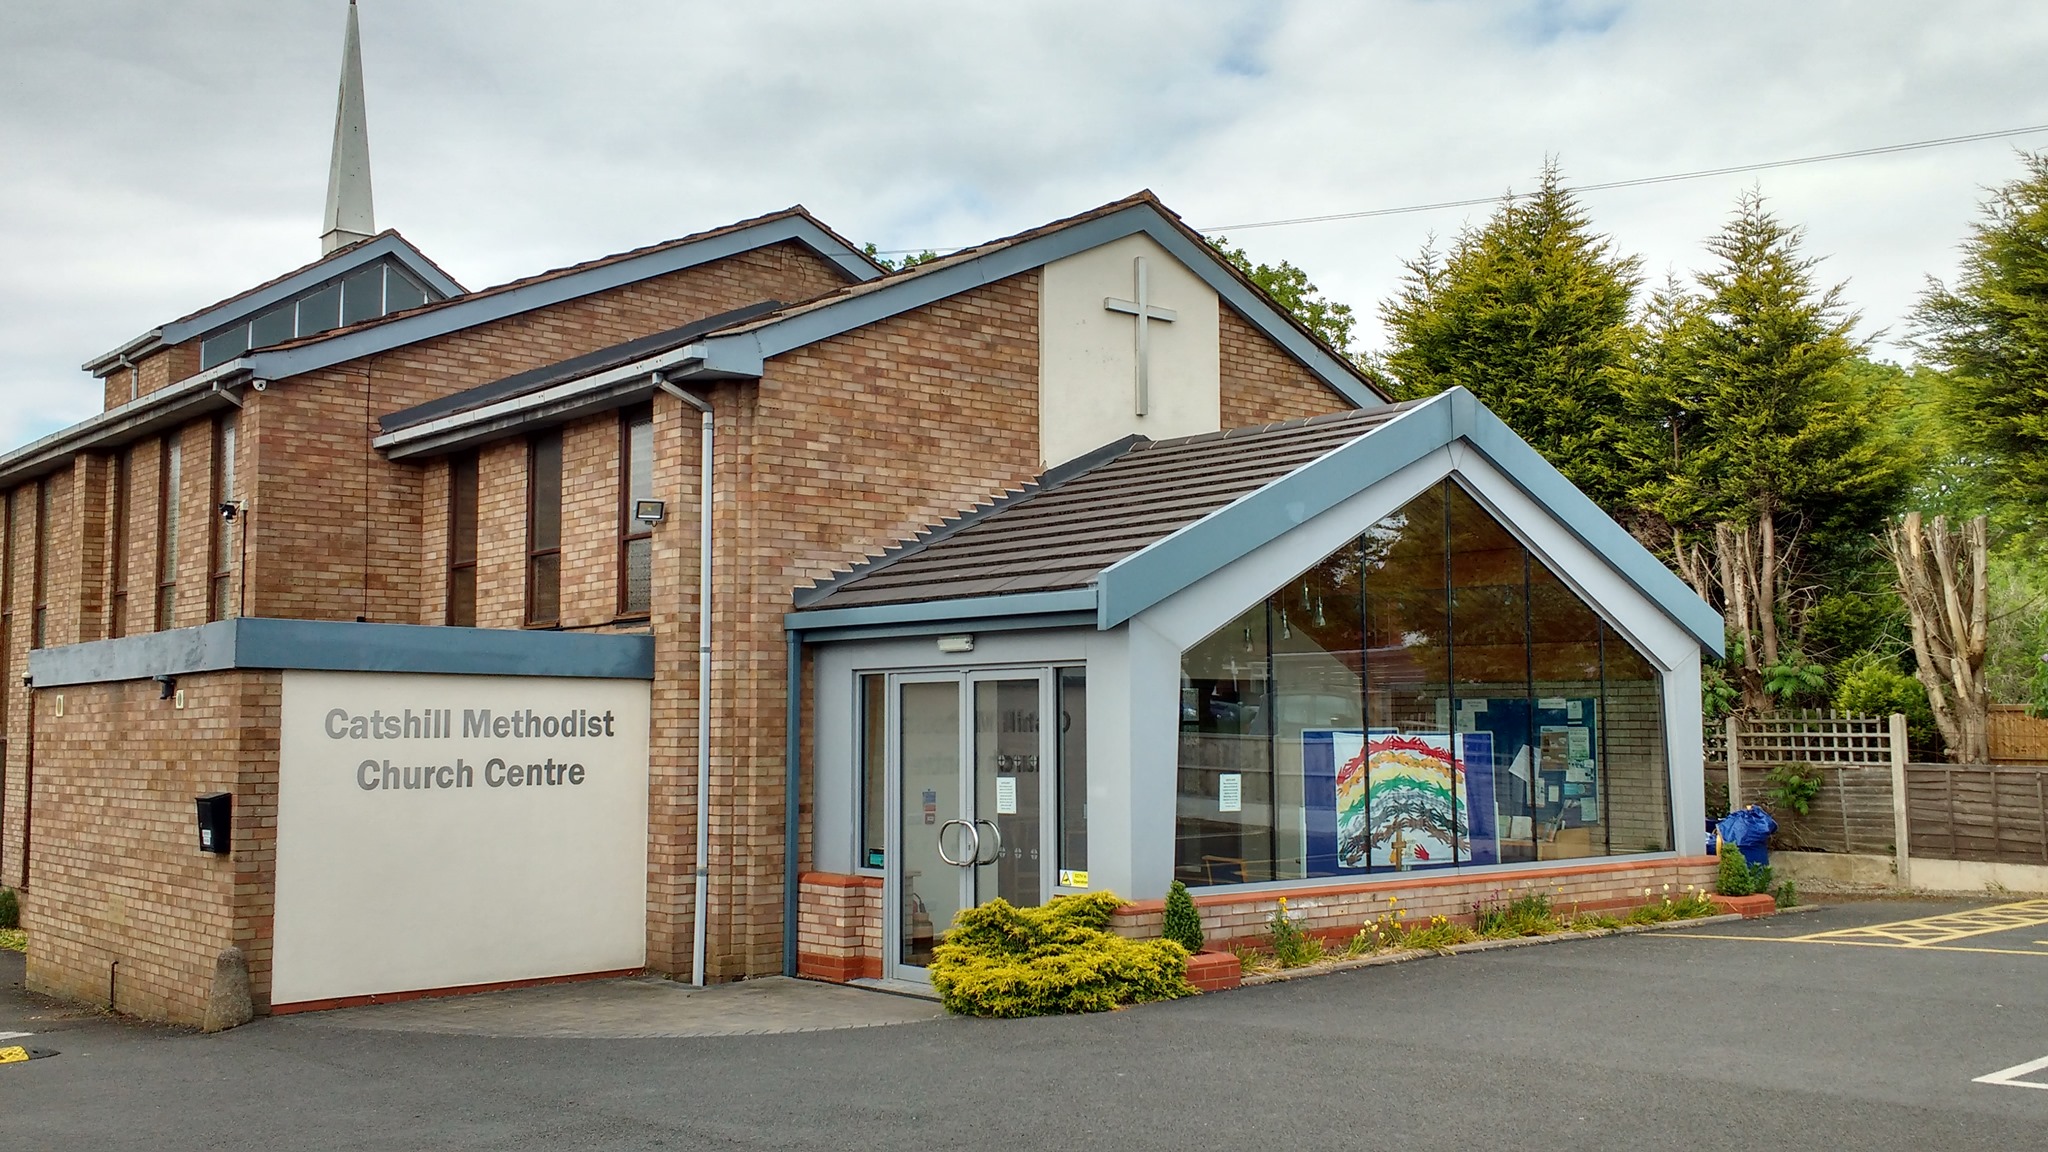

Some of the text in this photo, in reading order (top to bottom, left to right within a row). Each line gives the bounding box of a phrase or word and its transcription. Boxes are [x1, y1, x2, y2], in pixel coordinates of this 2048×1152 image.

[325, 708, 615, 740] Catshill Methodist
[357, 758, 586, 791] Church Centre
